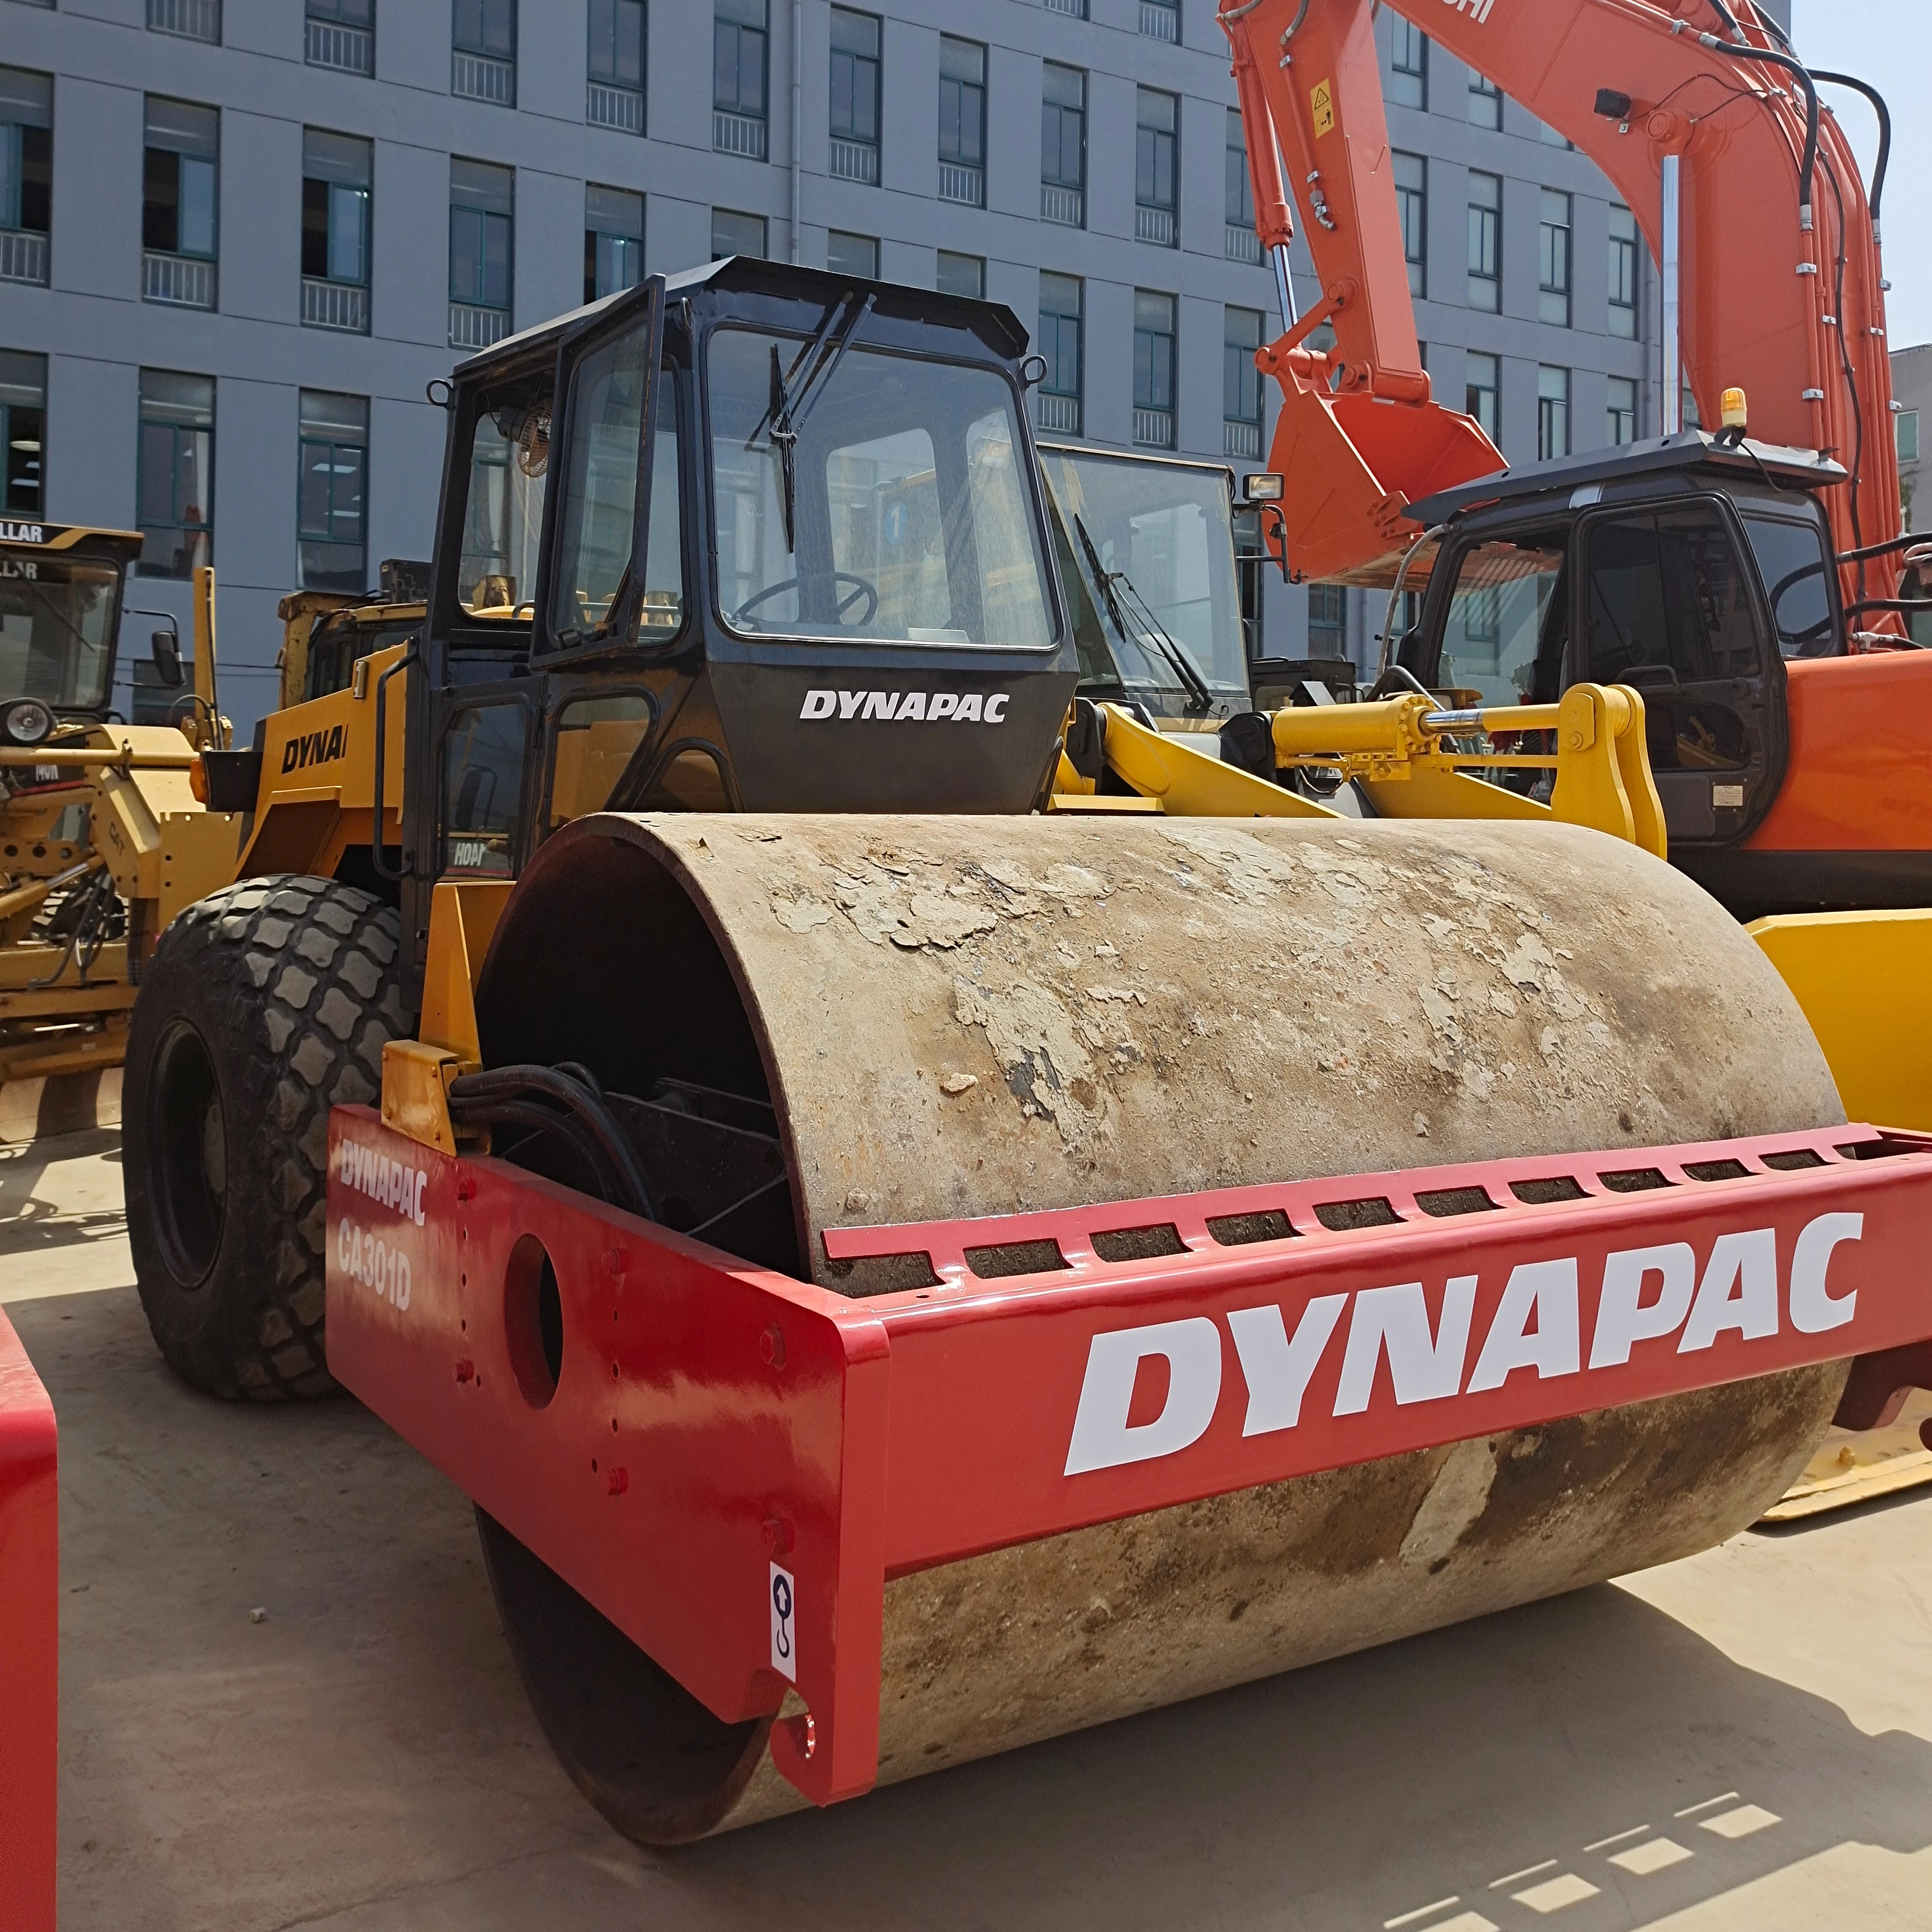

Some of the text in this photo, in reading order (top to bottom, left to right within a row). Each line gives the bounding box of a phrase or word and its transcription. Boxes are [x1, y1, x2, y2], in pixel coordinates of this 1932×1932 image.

[281, 724, 348, 775] DYNA
[799, 690, 1010, 723] DYNAPAC
[340, 1139, 427, 1227] DYNAPAC
[338, 1218, 411, 1311] CA301D
[1064, 1211, 1864, 1477] DYNAPAC
